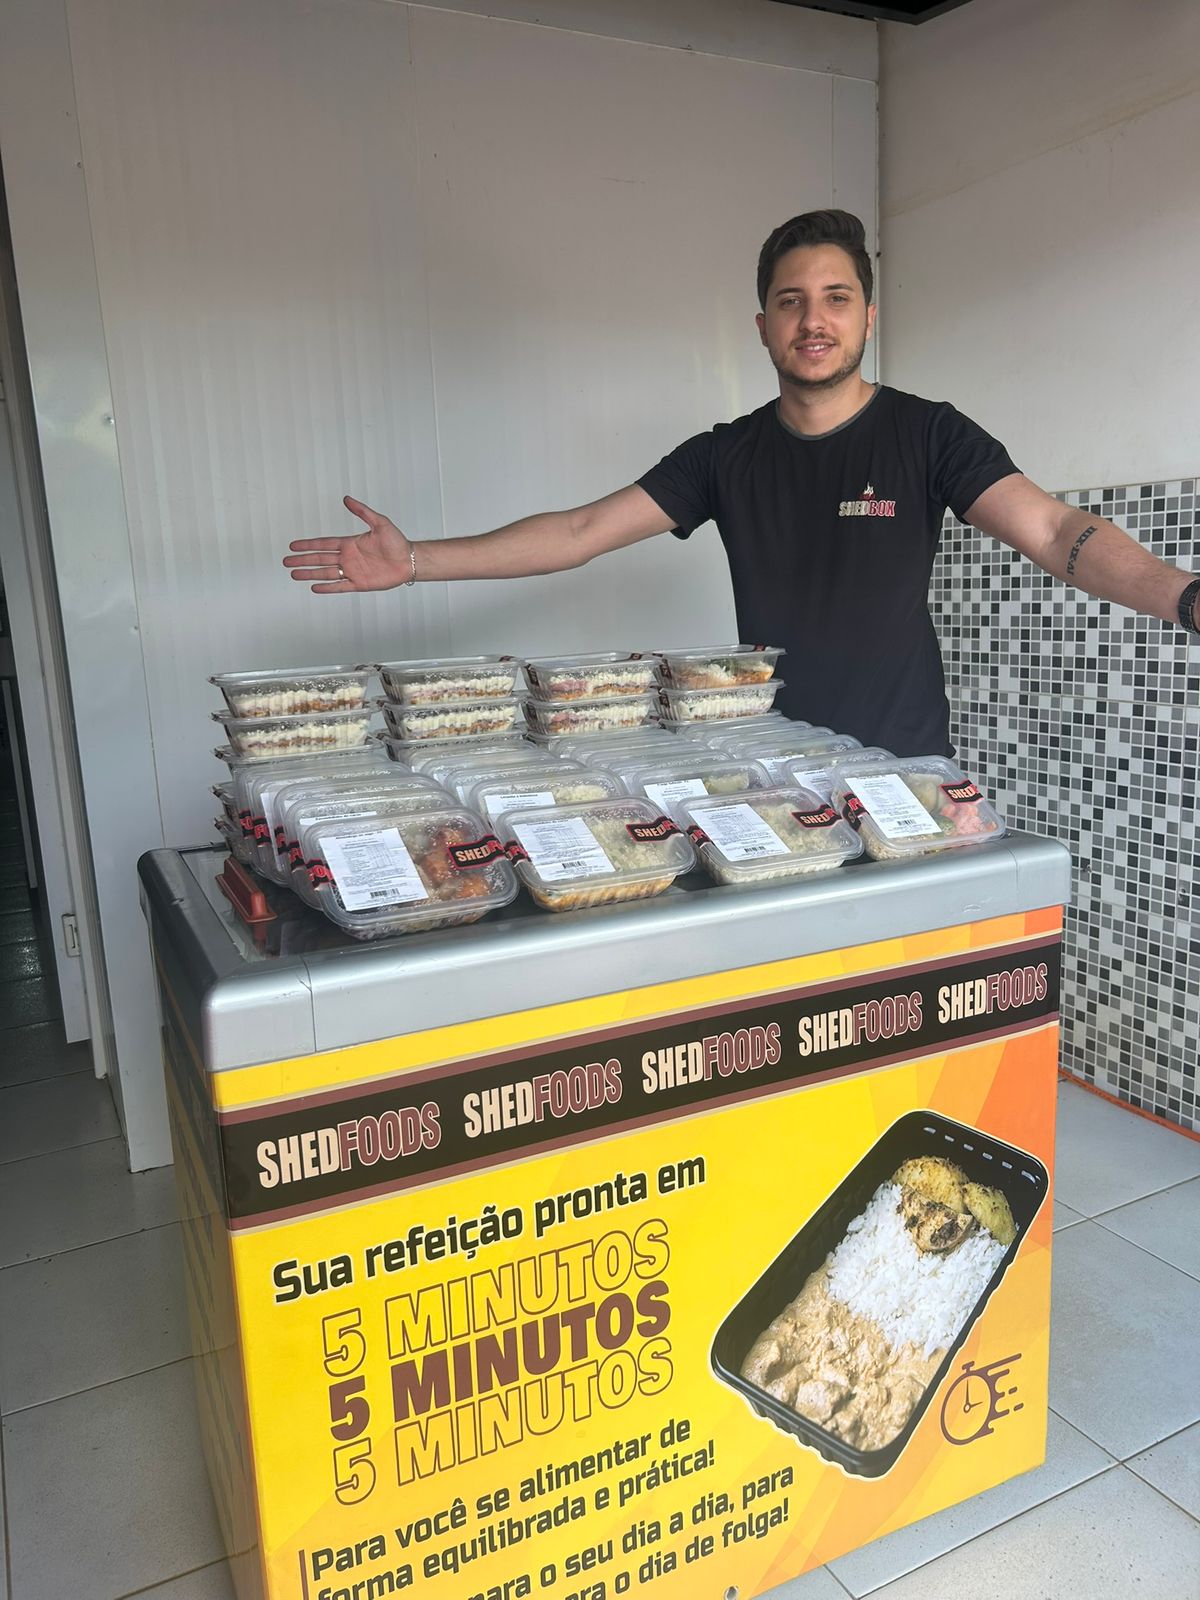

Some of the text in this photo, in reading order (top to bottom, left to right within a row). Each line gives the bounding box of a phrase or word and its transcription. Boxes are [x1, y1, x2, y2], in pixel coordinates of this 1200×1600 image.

[256, 962, 1048, 1189] SHEDFOODS SHEDFOODS SHEDFOODS SHEDFOODS SHEDFOODS
[273, 1156, 706, 1302] Sua refeição pronta em
[322, 1218, 671, 1377] 5 MINUTOS
[330, 1280, 671, 1441] 5 MINUTOS
[332, 1337, 673, 1505] 5 MINUTOS
[311, 1418, 691, 1582] Para você se alimentar de
[423, 1496, 586, 1578] equilibrada
[594, 1487, 610, 1510] e
[619, 1440, 715, 1507] prática!
[468, 1466, 793, 1600] ara o seu dia a dia, para
[615, 1571, 630, 1595] o
[639, 1550, 677, 1584] dia
[685, 1535, 714, 1564] de
[722, 1497, 789, 1548] folga!
